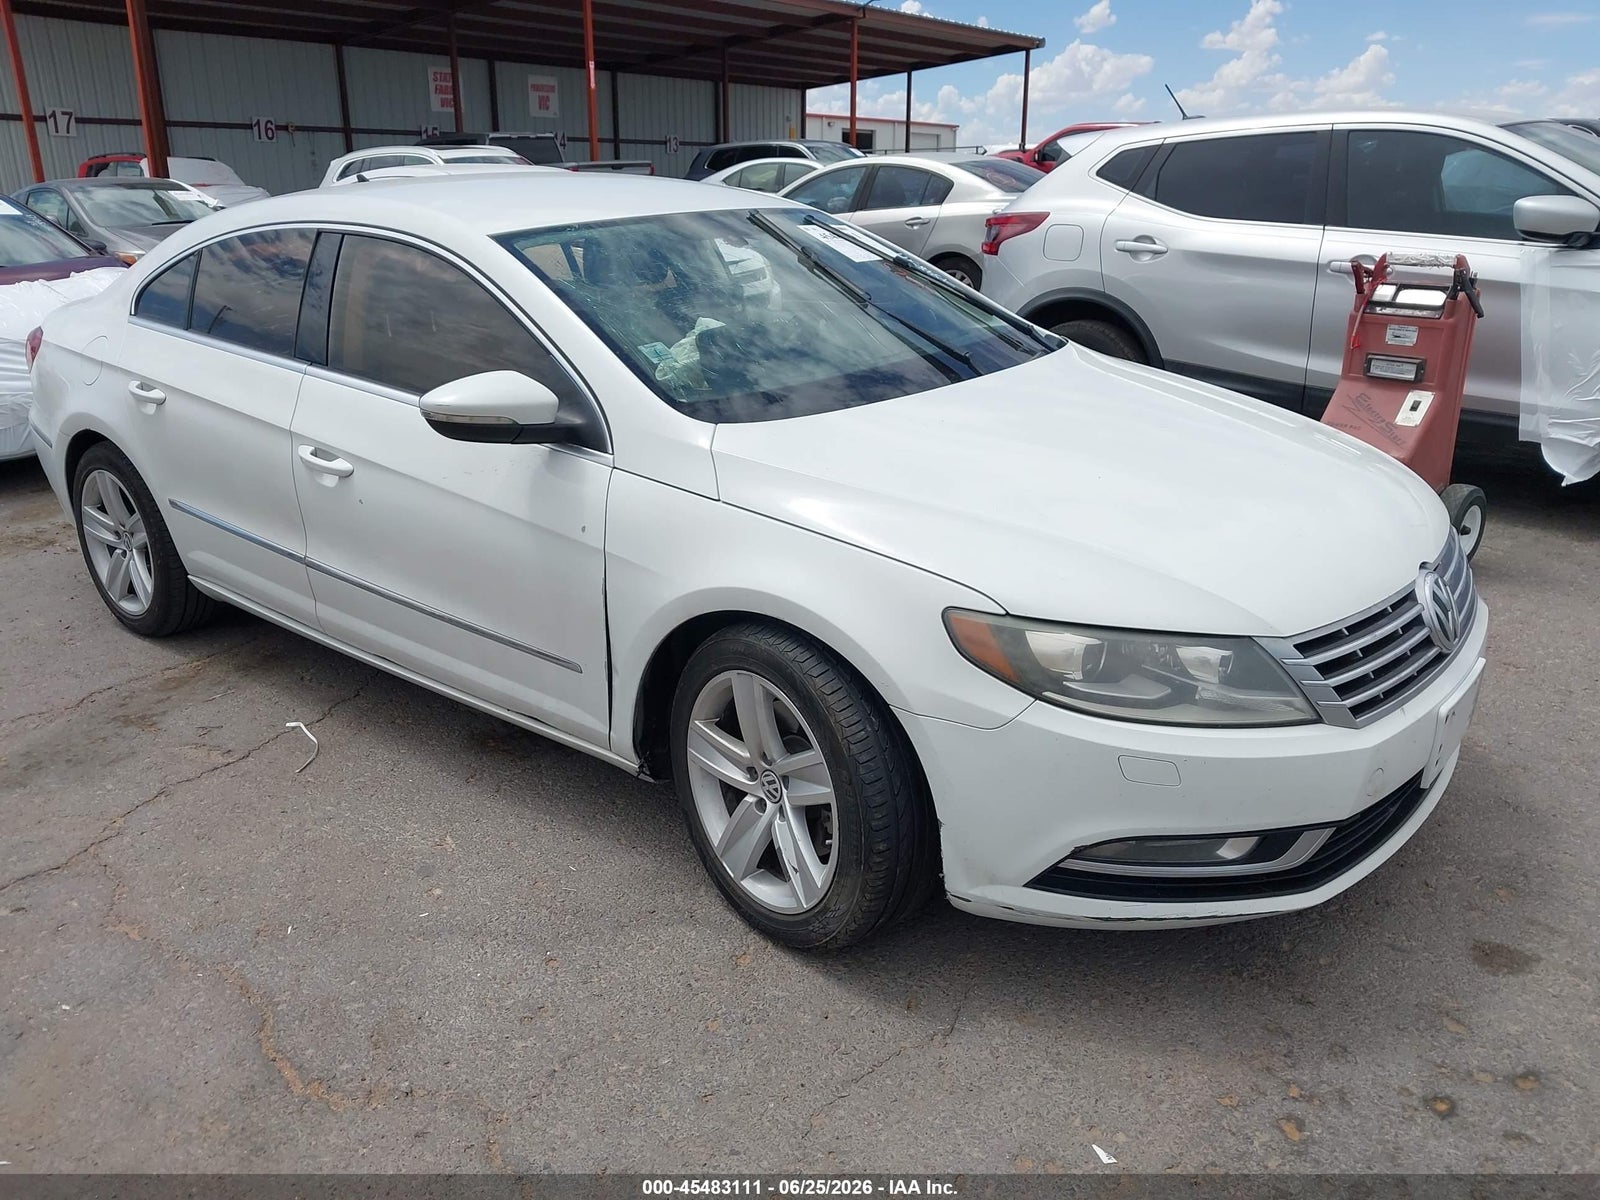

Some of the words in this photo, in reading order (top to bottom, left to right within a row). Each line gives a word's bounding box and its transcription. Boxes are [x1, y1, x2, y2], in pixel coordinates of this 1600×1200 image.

[538, 95, 550, 111] VIC
[48, 109, 74, 134] 17
[253, 118, 275, 140] 16
[668, 136, 679, 153] 13
